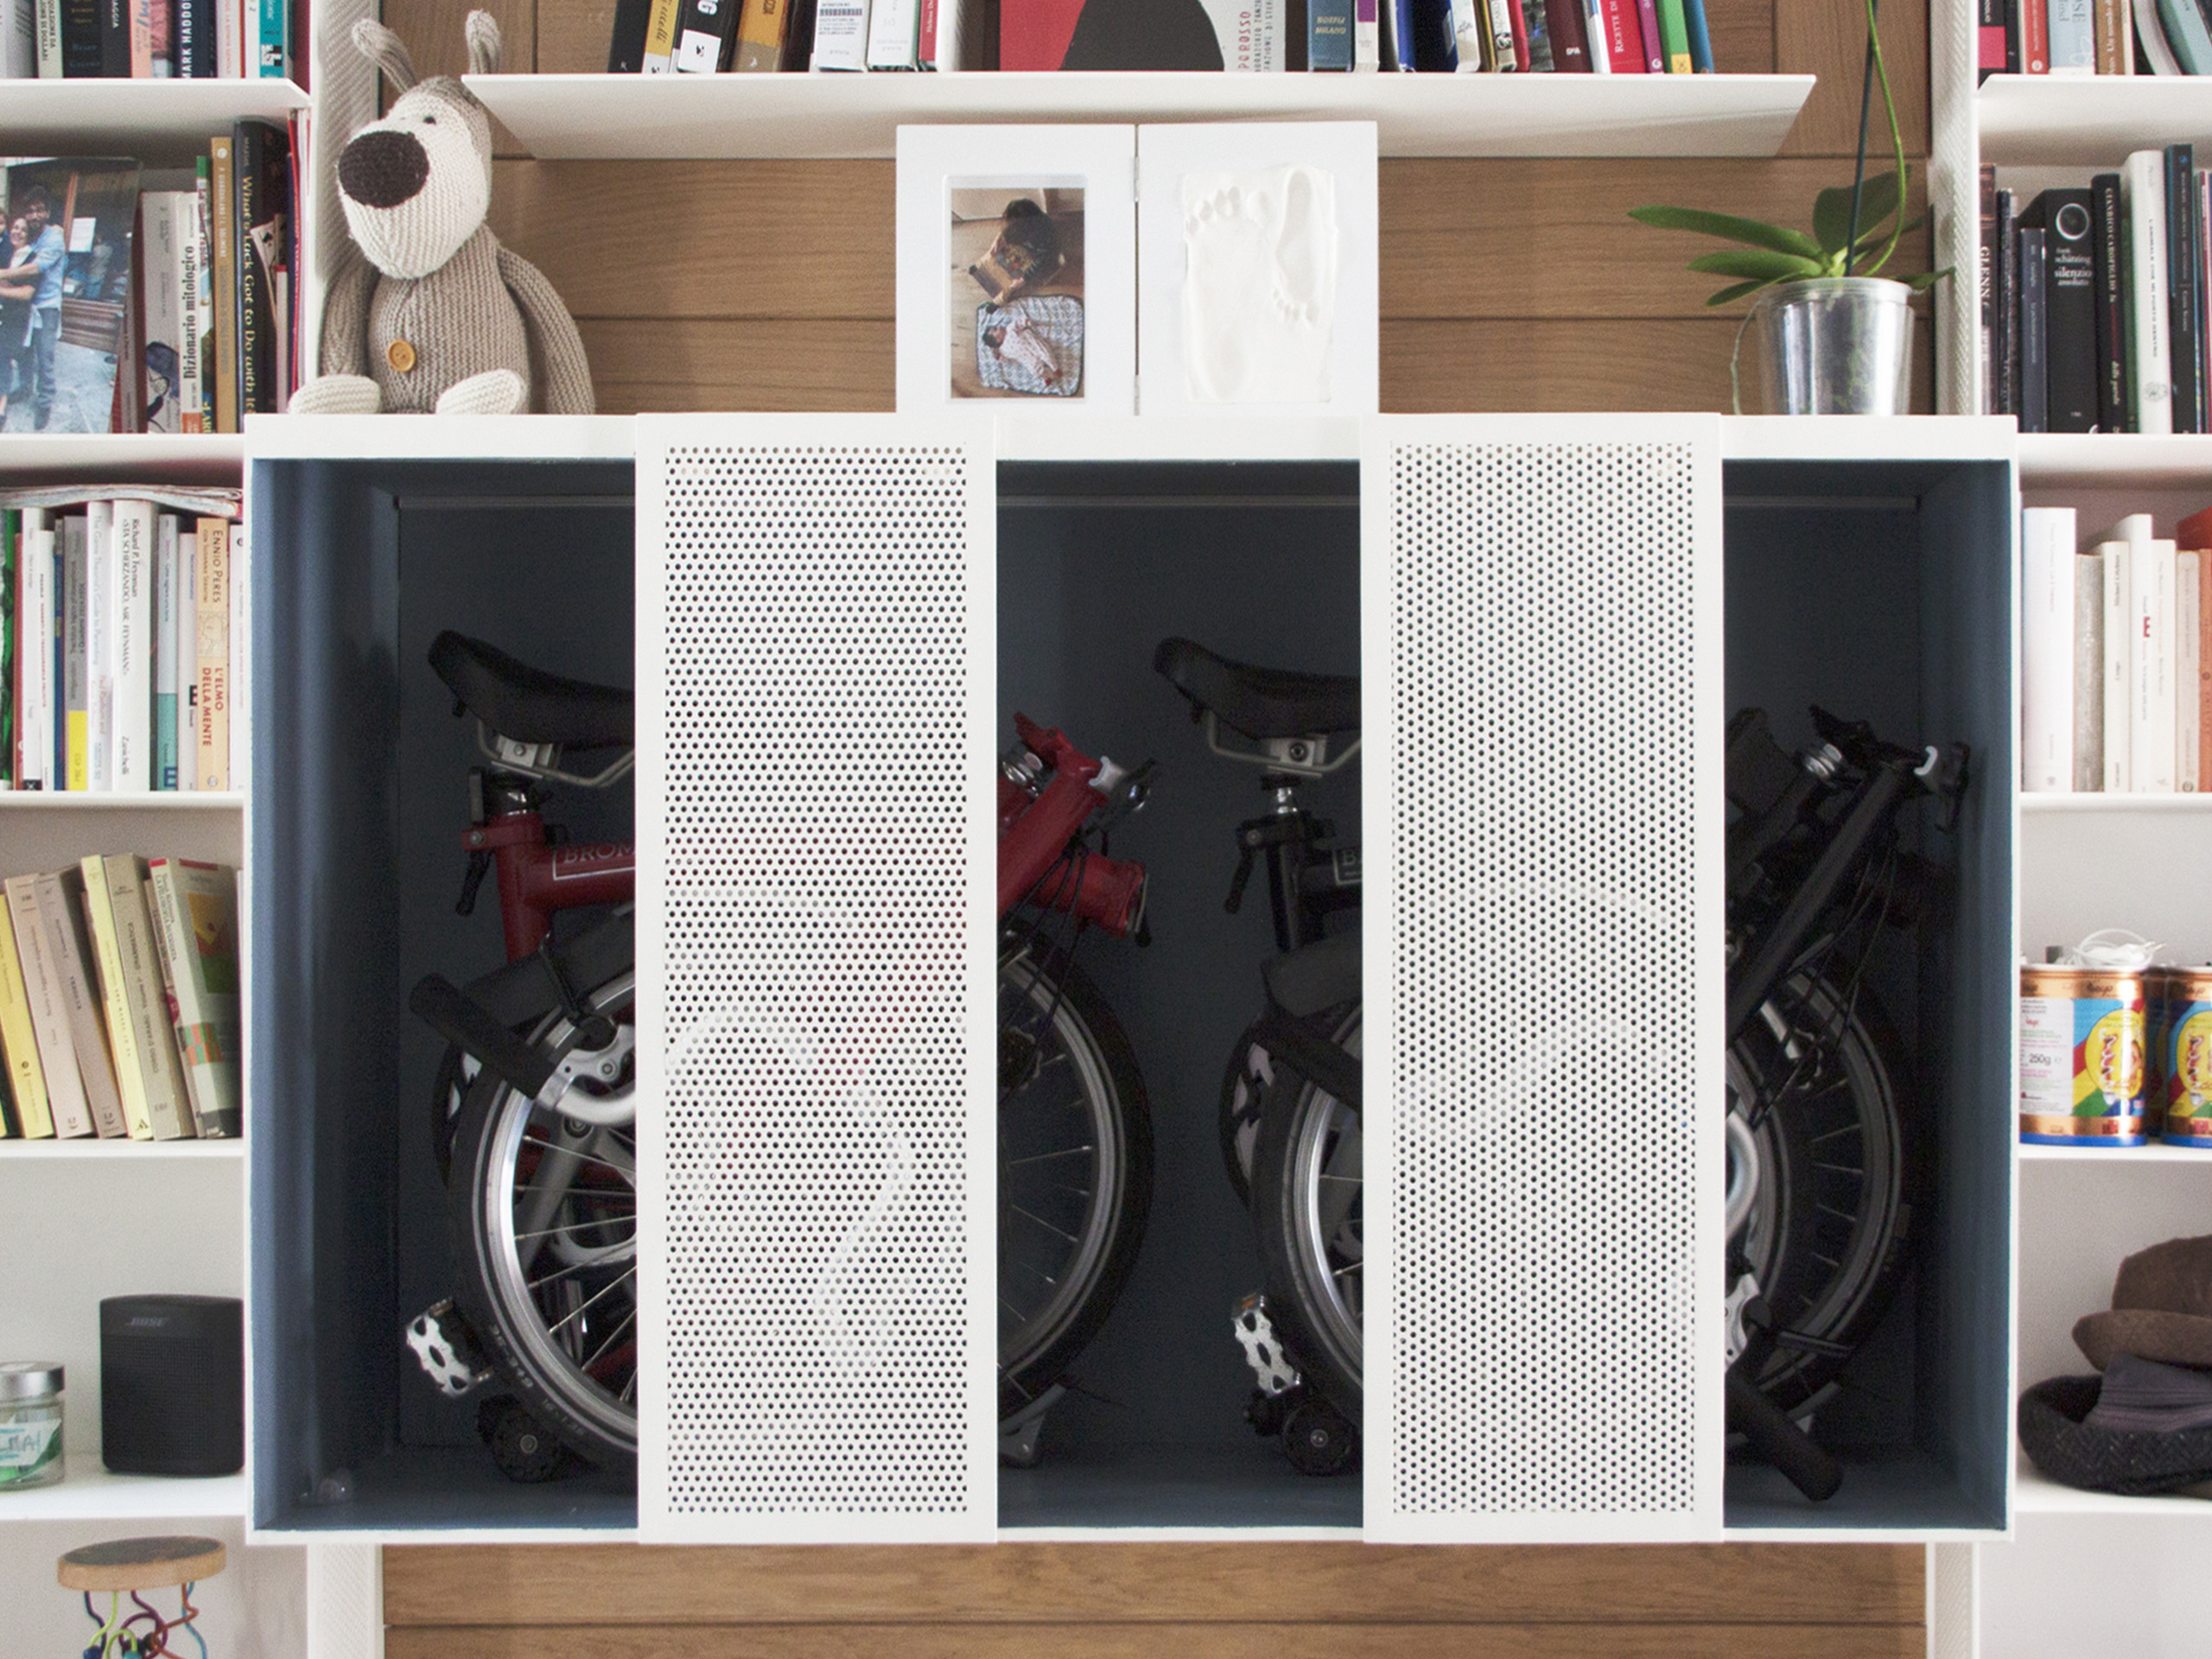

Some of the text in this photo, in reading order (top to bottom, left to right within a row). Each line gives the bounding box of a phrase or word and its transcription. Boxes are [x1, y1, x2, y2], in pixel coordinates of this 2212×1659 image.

[111, 0, 120, 29] AGGIA
[181, 0, 193, 43] HADDO
[1315, 26, 1347, 35] MILANO
[1611, 15, 1624, 53] RICETTE
[241, 175, 253, 230] What's
[243, 235, 254, 269] Luck
[181, 246, 196, 311] mitologico
[1980, 245, 1991, 296] GLENN
[2054, 266, 2093, 277] silenzio
[245, 274, 257, 304] Got
[245, 308, 254, 325] to
[182, 315, 197, 379] Dizionario
[245, 330, 257, 351] Do
[245, 356, 256, 392] with
[131, 561, 140, 597] Feynman
[212, 530, 224, 602] ENNIO PERES
[202, 667, 213, 747] DELLA MENTE
[214, 667, 224, 711] L'ELMO
[2029, 1053, 2051, 1066] 250g
